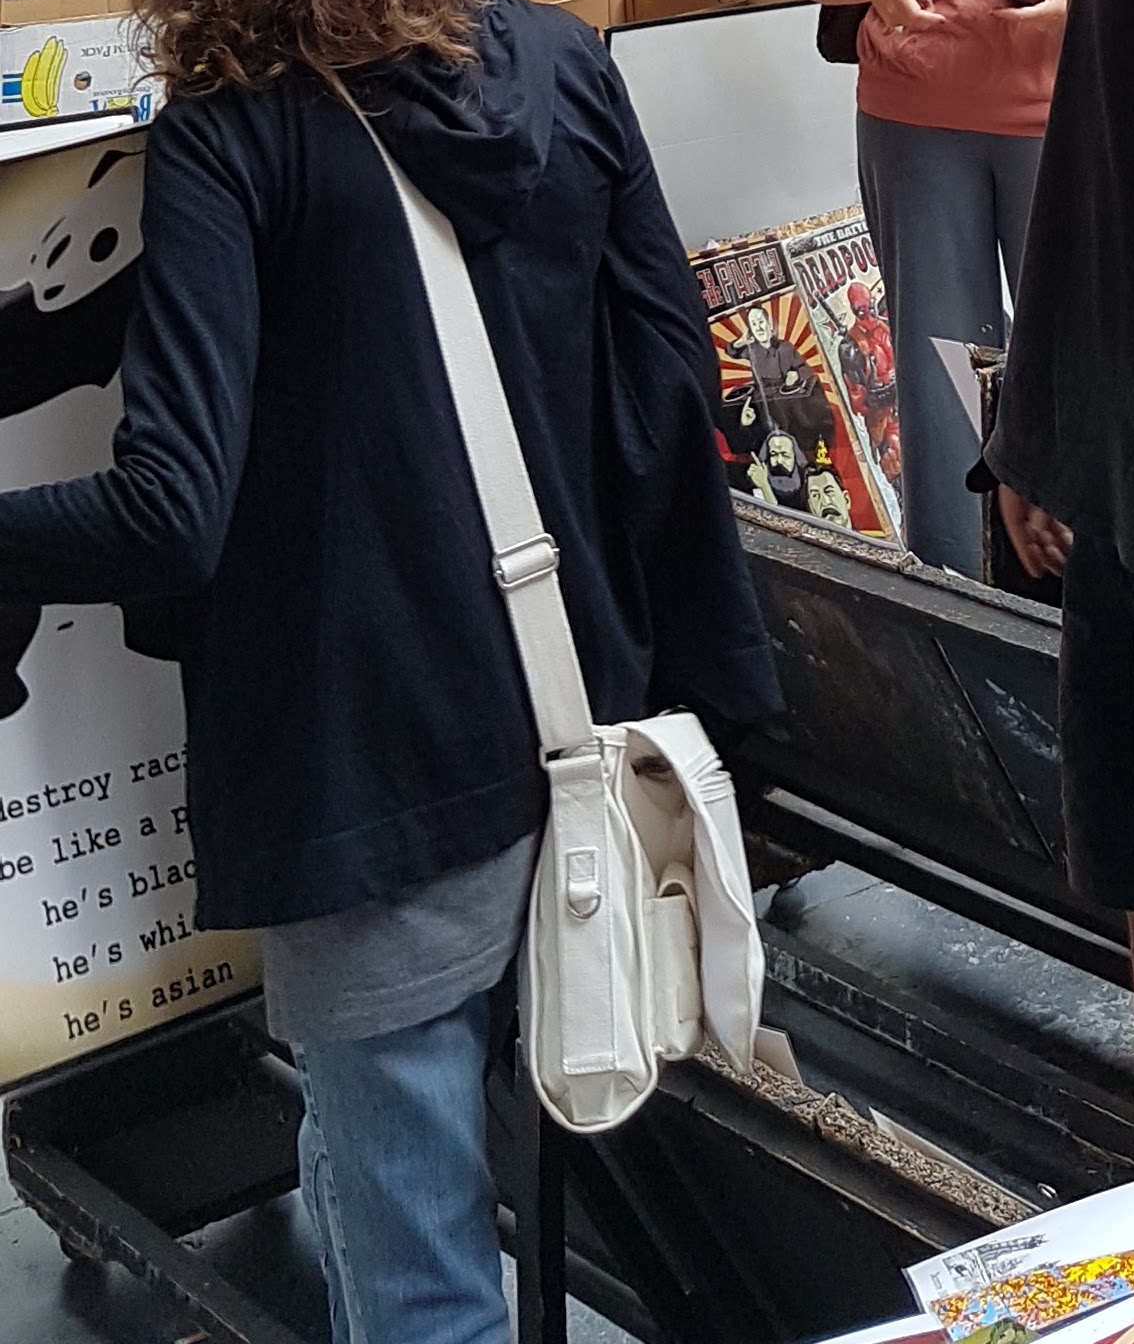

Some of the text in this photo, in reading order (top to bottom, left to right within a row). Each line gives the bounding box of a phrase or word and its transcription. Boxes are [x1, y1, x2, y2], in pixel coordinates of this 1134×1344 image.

[816, 220, 870, 247] THE BATTL
[792, 235, 878, 310] DEADPOO
[52, 826, 122, 865] like
[140, 815, 158, 838] a
[41, 859, 197, 927] he's blac
[52, 913, 192, 983] he's whi
[64, 961, 234, 1040] he's asian
